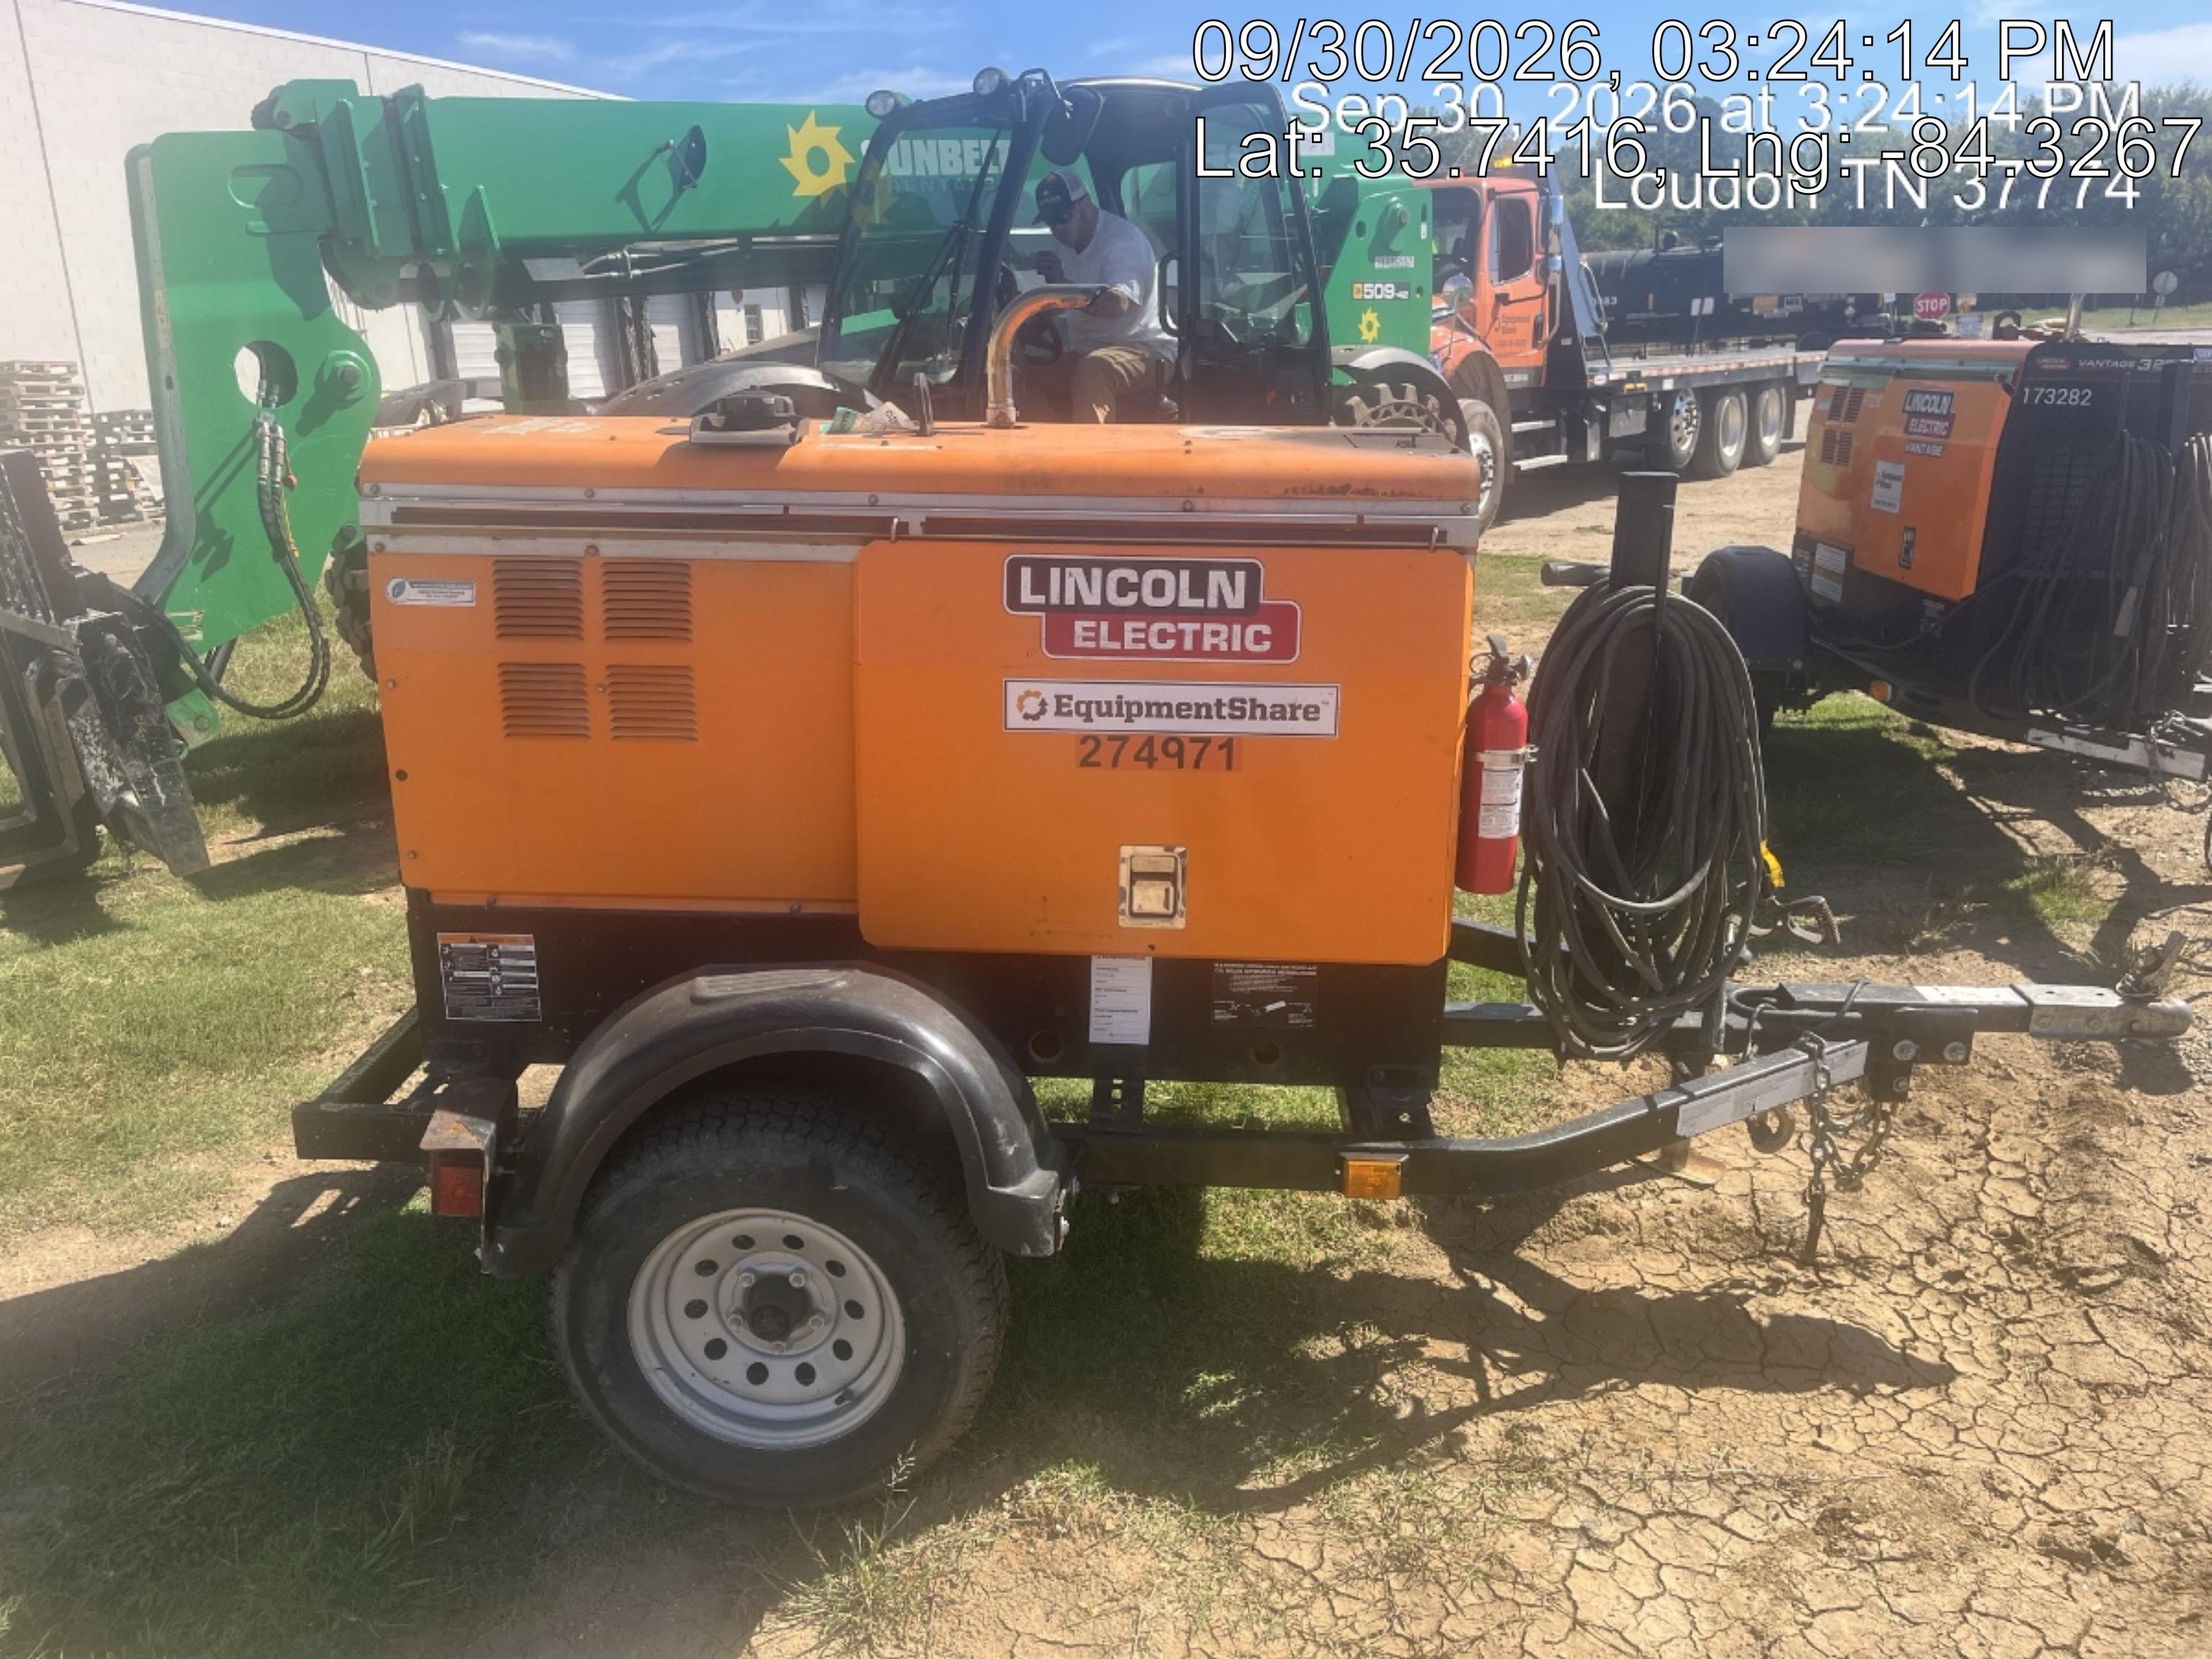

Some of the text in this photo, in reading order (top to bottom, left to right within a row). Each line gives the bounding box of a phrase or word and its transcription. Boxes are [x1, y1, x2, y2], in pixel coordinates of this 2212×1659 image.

[1916, 298, 1948, 313] STOP
[2078, 358, 2136, 367] VANTAGE
[1905, 393, 1951, 415] LINCOLN
[2023, 387, 2093, 407] 173282
[1908, 418, 1949, 436] ELECTRIC
[1020, 565, 1247, 610] LINCOLN
[1073, 620, 1272, 652] ELECTRIC
[1078, 735, 1235, 772] 274971
